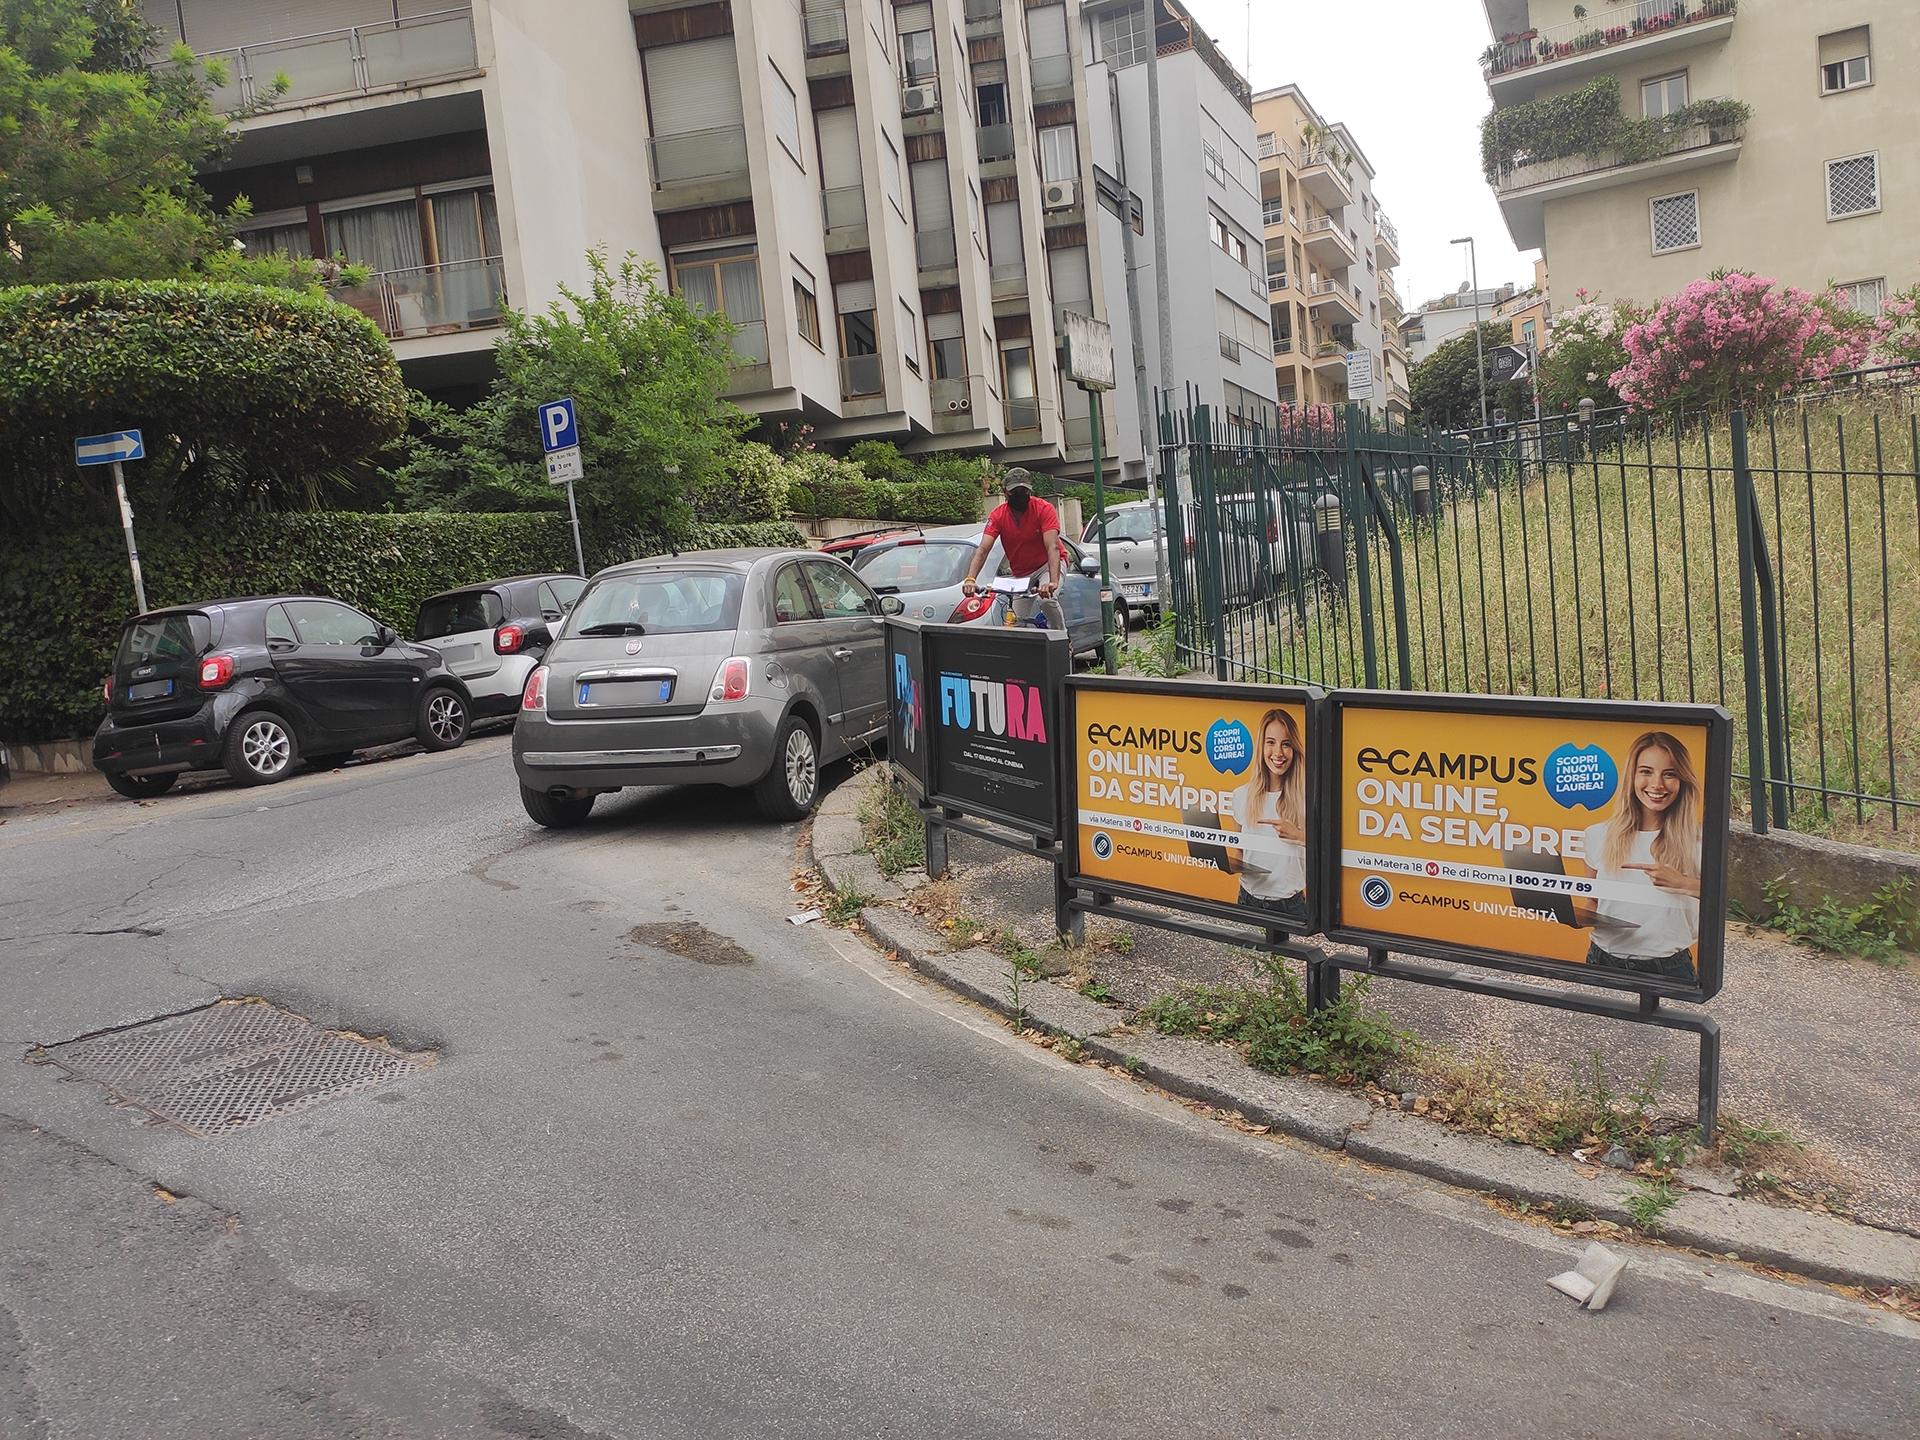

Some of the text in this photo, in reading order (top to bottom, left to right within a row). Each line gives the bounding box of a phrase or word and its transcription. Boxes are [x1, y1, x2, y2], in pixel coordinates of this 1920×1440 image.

[546, 405, 569, 447] P
[940, 674, 1047, 744] FUTURA
[1213, 728, 1240, 738] SCOPRI
[1217, 735, 1241, 745] NUOVI
[1213, 742, 1245, 753] CORSI DI
[1213, 750, 1245, 760] LAUREA!
[1004, 759, 1025, 769] CINEMA
[1087, 749, 1185, 786] ONLINE,
[1556, 754, 1598, 766] SCOPRI
[1556, 763, 1599, 775] I NUOVI
[1556, 772, 1605, 784] CORSI DI
[1089, 775, 1235, 816] DA SEMPRE
[1556, 781, 1604, 793] LAUREA!
[1356, 777, 1509, 822] ONLINE,
[1088, 815, 1099, 823] via
[1099, 816, 1123, 828] Matera
[1124, 820, 1132, 828] 18
[1144, 822, 1153, 832] Re
[1154, 823, 1162, 833] di
[1162, 825, 1184, 837] Roma
[1190, 829, 1205, 839] 800
[1206, 832, 1217, 841] 27
[1218, 833, 1227, 842] 17
[1228, 834, 1240, 844] 89
[1358, 809, 1586, 859] DA SEMPRE
[1164, 853, 1220, 870] UNIVERSITÀ
[1357, 856, 1372, 866] via
[1373, 858, 1410, 871] Matera
[1411, 861, 1423, 872] 18
[1442, 866, 1457, 877] Re
[1459, 867, 1470, 878] di
[1472, 870, 1506, 883] Roma
[1515, 875, 1539, 887] 800
[1541, 877, 1557, 888] 27
[1559, 879, 1573, 890] 17
[1575, 880, 1593, 893] 89
[1473, 900, 1560, 924] UNIVERSITÀ
